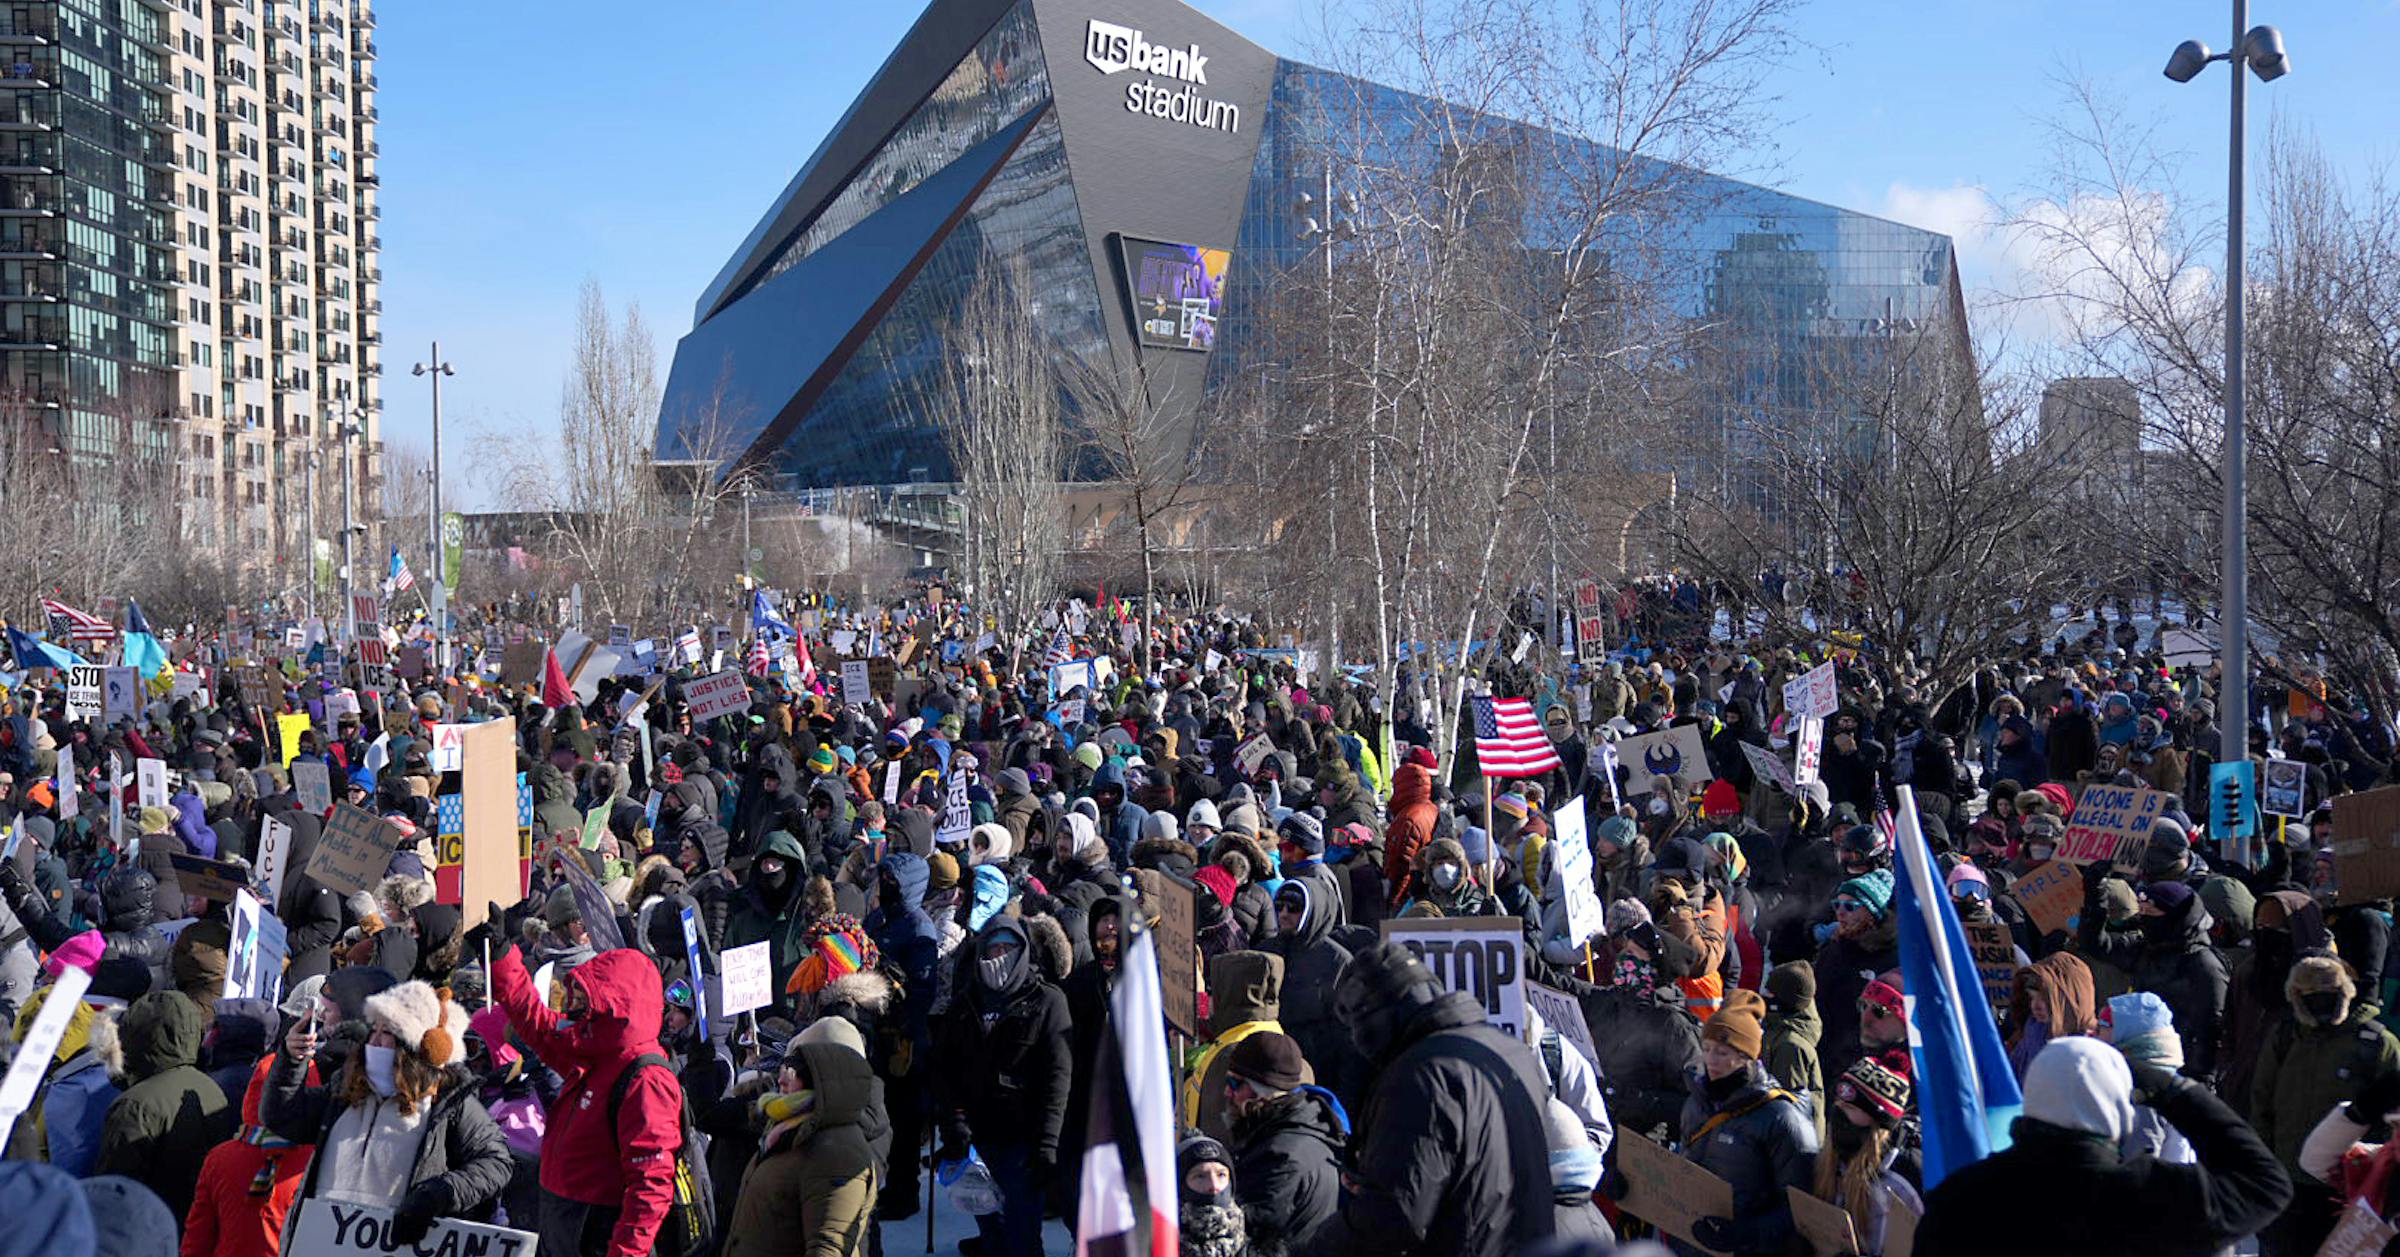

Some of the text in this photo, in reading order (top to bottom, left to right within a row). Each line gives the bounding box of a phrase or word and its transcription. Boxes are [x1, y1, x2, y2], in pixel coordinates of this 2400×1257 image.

[1126, 79, 1239, 133] stadium
[354, 596, 378, 621] NO
[1580, 618, 1600, 640] NO
[360, 640, 383, 664] NO
[1582, 641, 1602, 659] ICE
[71, 667, 100, 687] STO
[364, 666, 386, 687] ICE
[845, 663, 861, 673] ICE
[690, 674, 740, 698] JUSTICE
[690, 690, 748, 720] NOT LIES
[2141, 794, 2157, 813] IS
[2130, 816, 2152, 832] ON
[2020, 863, 2071, 900] MPLS
[331, 1205, 400, 1253] YOU
